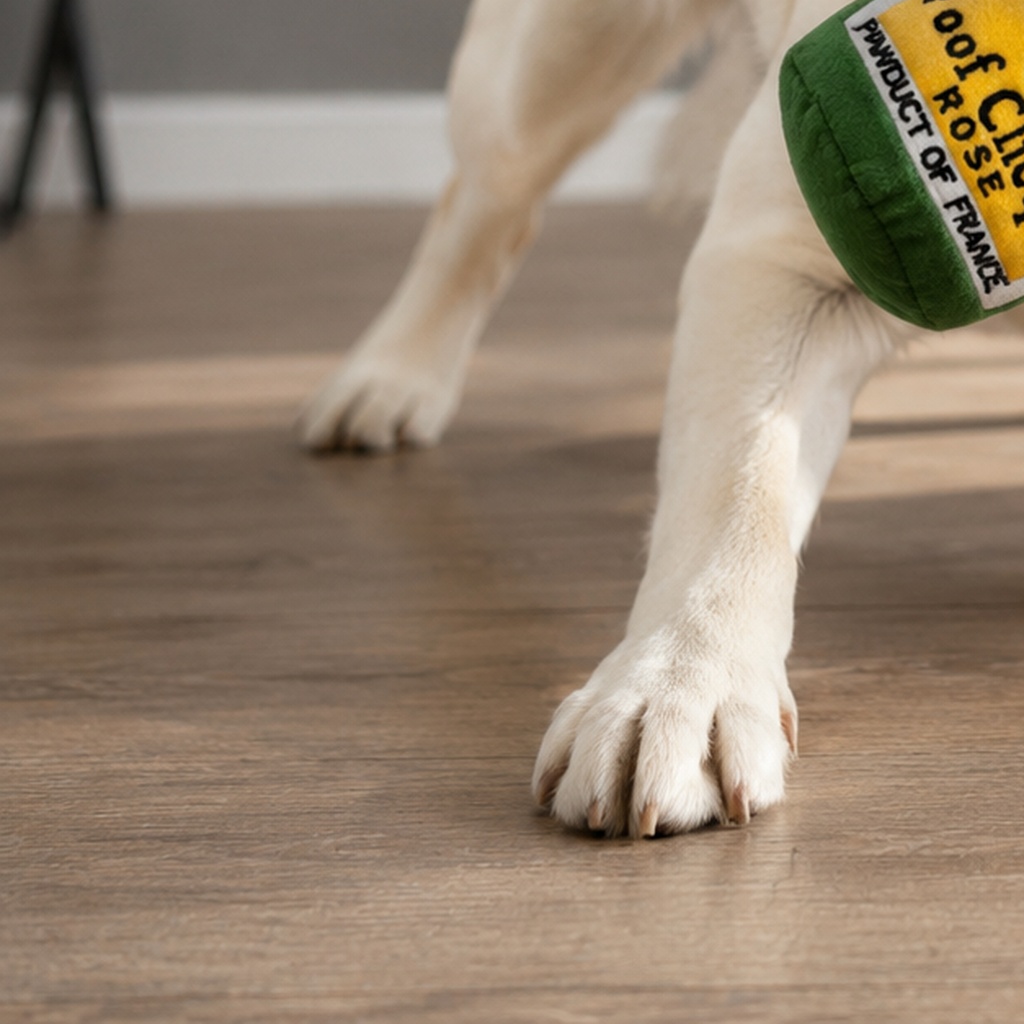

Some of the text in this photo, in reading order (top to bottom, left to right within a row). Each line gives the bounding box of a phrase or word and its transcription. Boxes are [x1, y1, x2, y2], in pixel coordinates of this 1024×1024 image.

[932, 85, 1005, 198] ROSE
[919, 145, 957, 183] OF
[943, 195, 1011, 294] FRANCE
